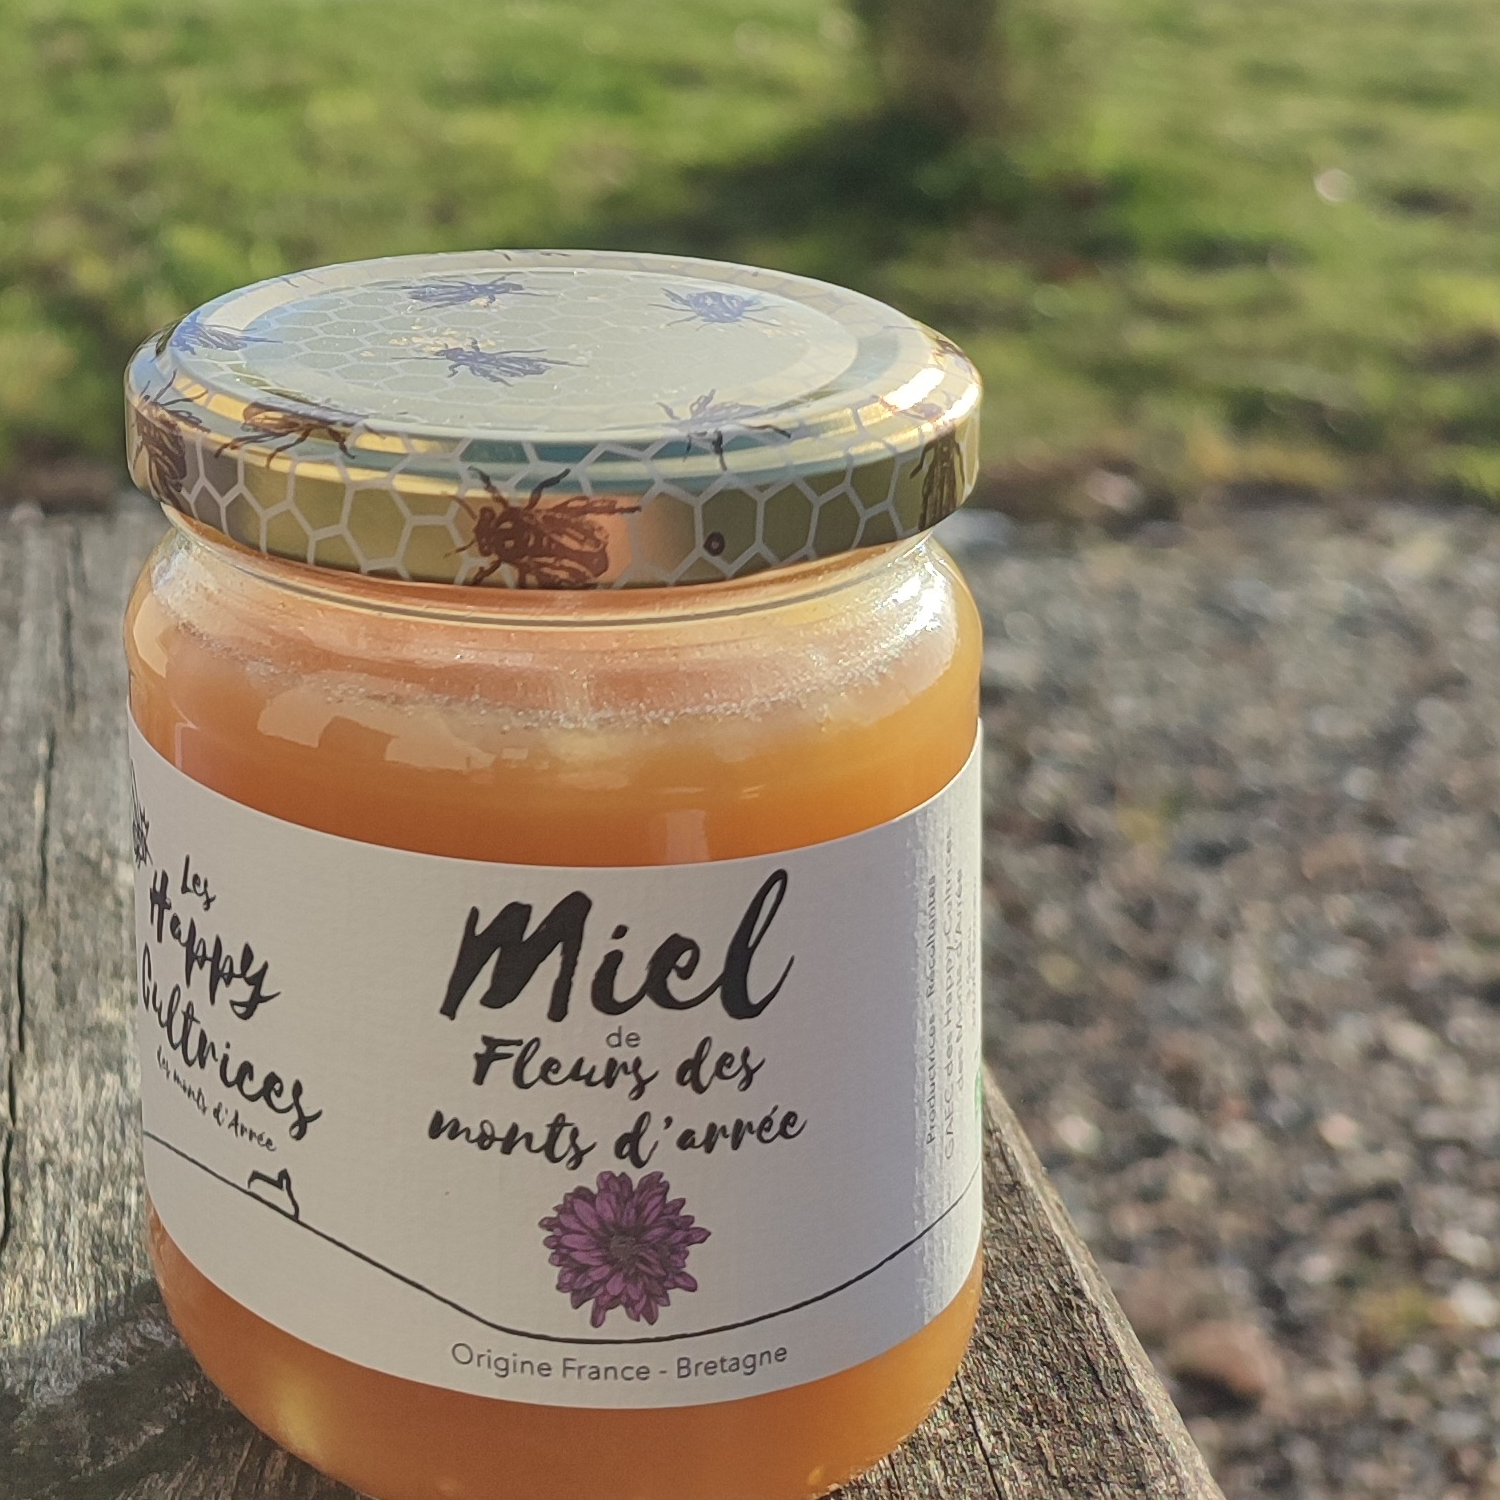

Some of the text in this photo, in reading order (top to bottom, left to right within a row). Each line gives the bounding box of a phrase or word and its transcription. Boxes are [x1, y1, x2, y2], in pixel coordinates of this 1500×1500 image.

[181, 854, 216, 911] Les
[150, 868, 281, 1020] Happy
[439, 868, 796, 1022] Miel
[142, 942, 323, 1141] Cultrices
[472, 1034, 766, 1101] Fleurs des
[605, 1025, 641, 1049] de
[428, 1104, 808, 1171] monts d'arrée
[451, 1342, 553, 1378] Origine
[562, 1357, 651, 1381] France
[676, 1346, 788, 1380] Bretagne
